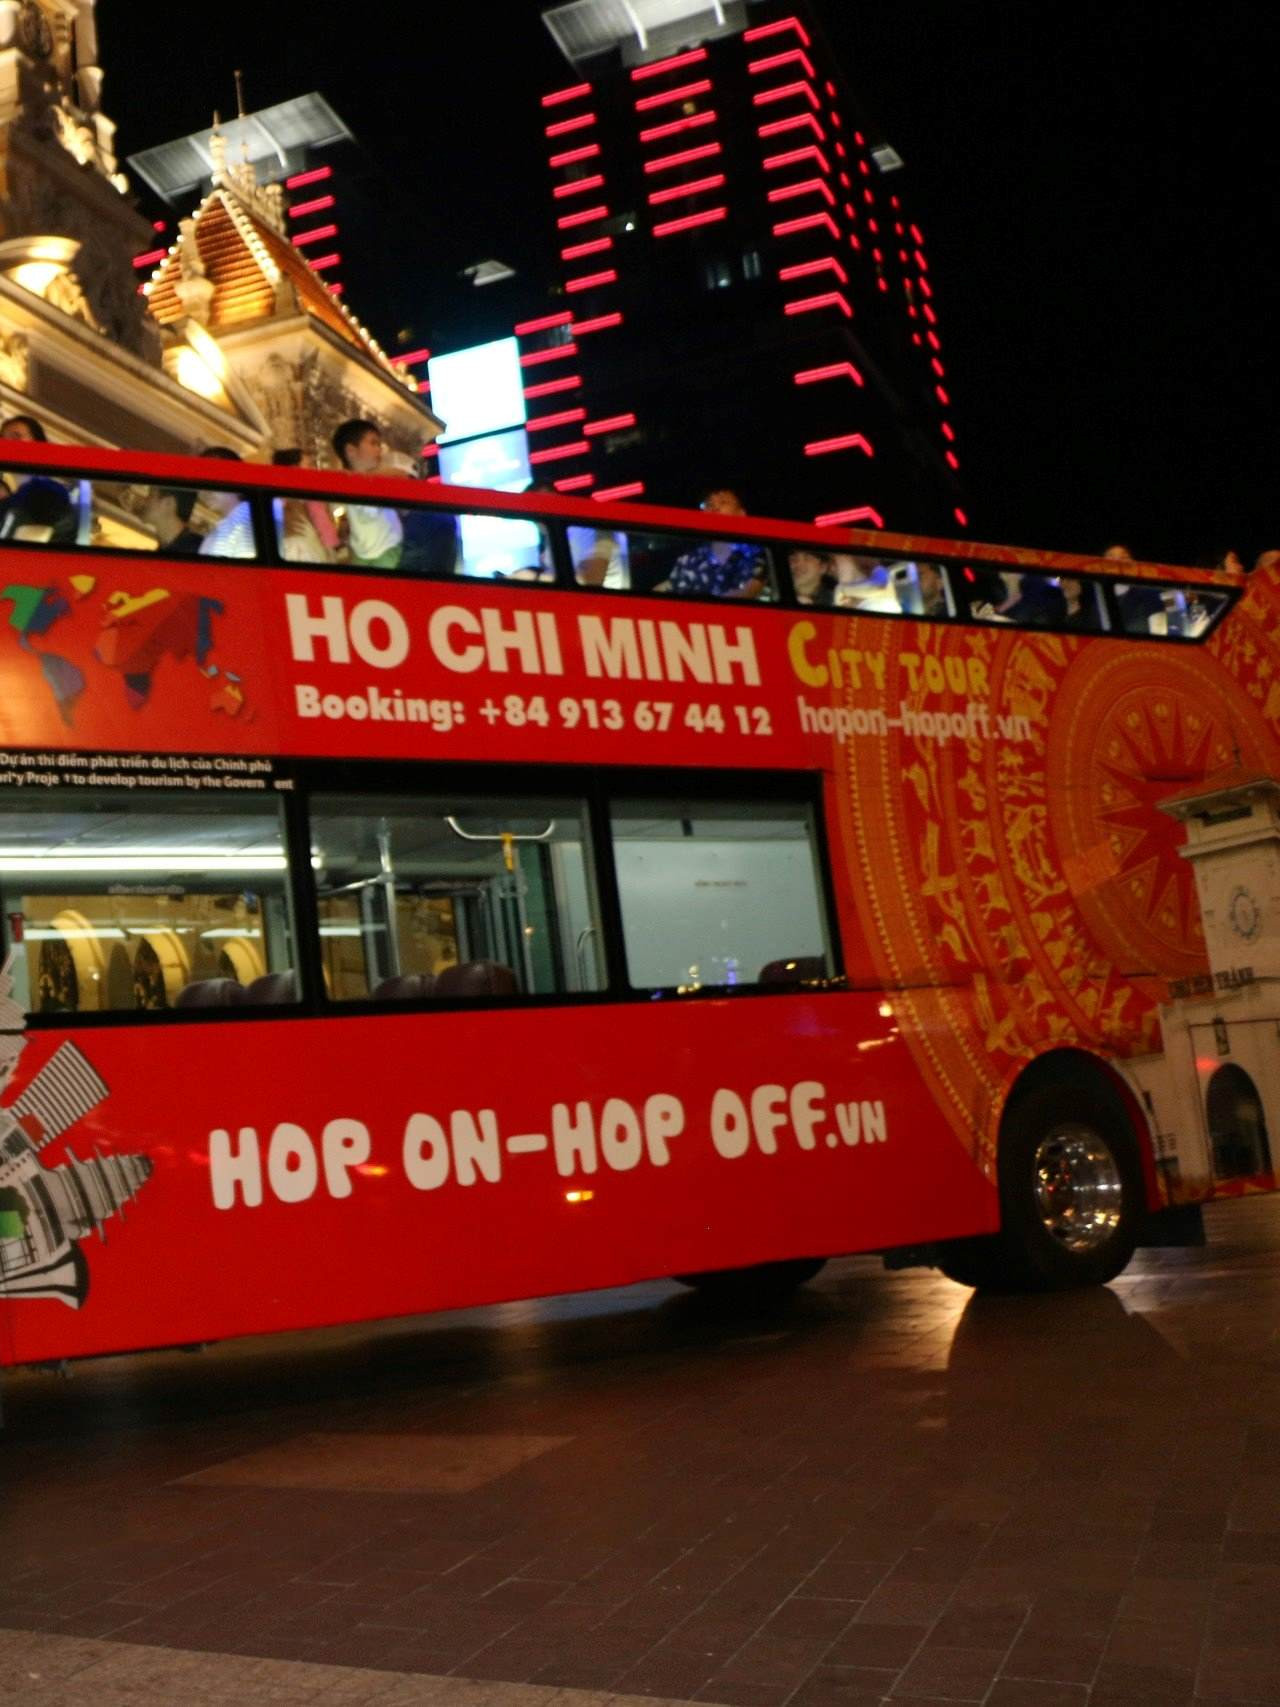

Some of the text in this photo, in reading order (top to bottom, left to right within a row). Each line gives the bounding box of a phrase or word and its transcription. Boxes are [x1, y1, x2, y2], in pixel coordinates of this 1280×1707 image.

[285, 593, 762, 687] HO CHI MINH
[898, 651, 991, 695] TOUR
[295, 685, 773, 736] Booking: +84 913 67 44 12
[797, 695, 1033, 747] hopon-hopoff.vn
[27, 771, 70, 787] Projet
[73, 773, 86, 785] to
[88, 772, 137, 788] develop
[138, 775, 184, 787] tourism
[186, 774, 200, 789] by
[202, 776, 223, 788] the
[151, 757, 167, 769] du
[209, 1080, 888, 1210] HOP ON-HOP OFF.VN
